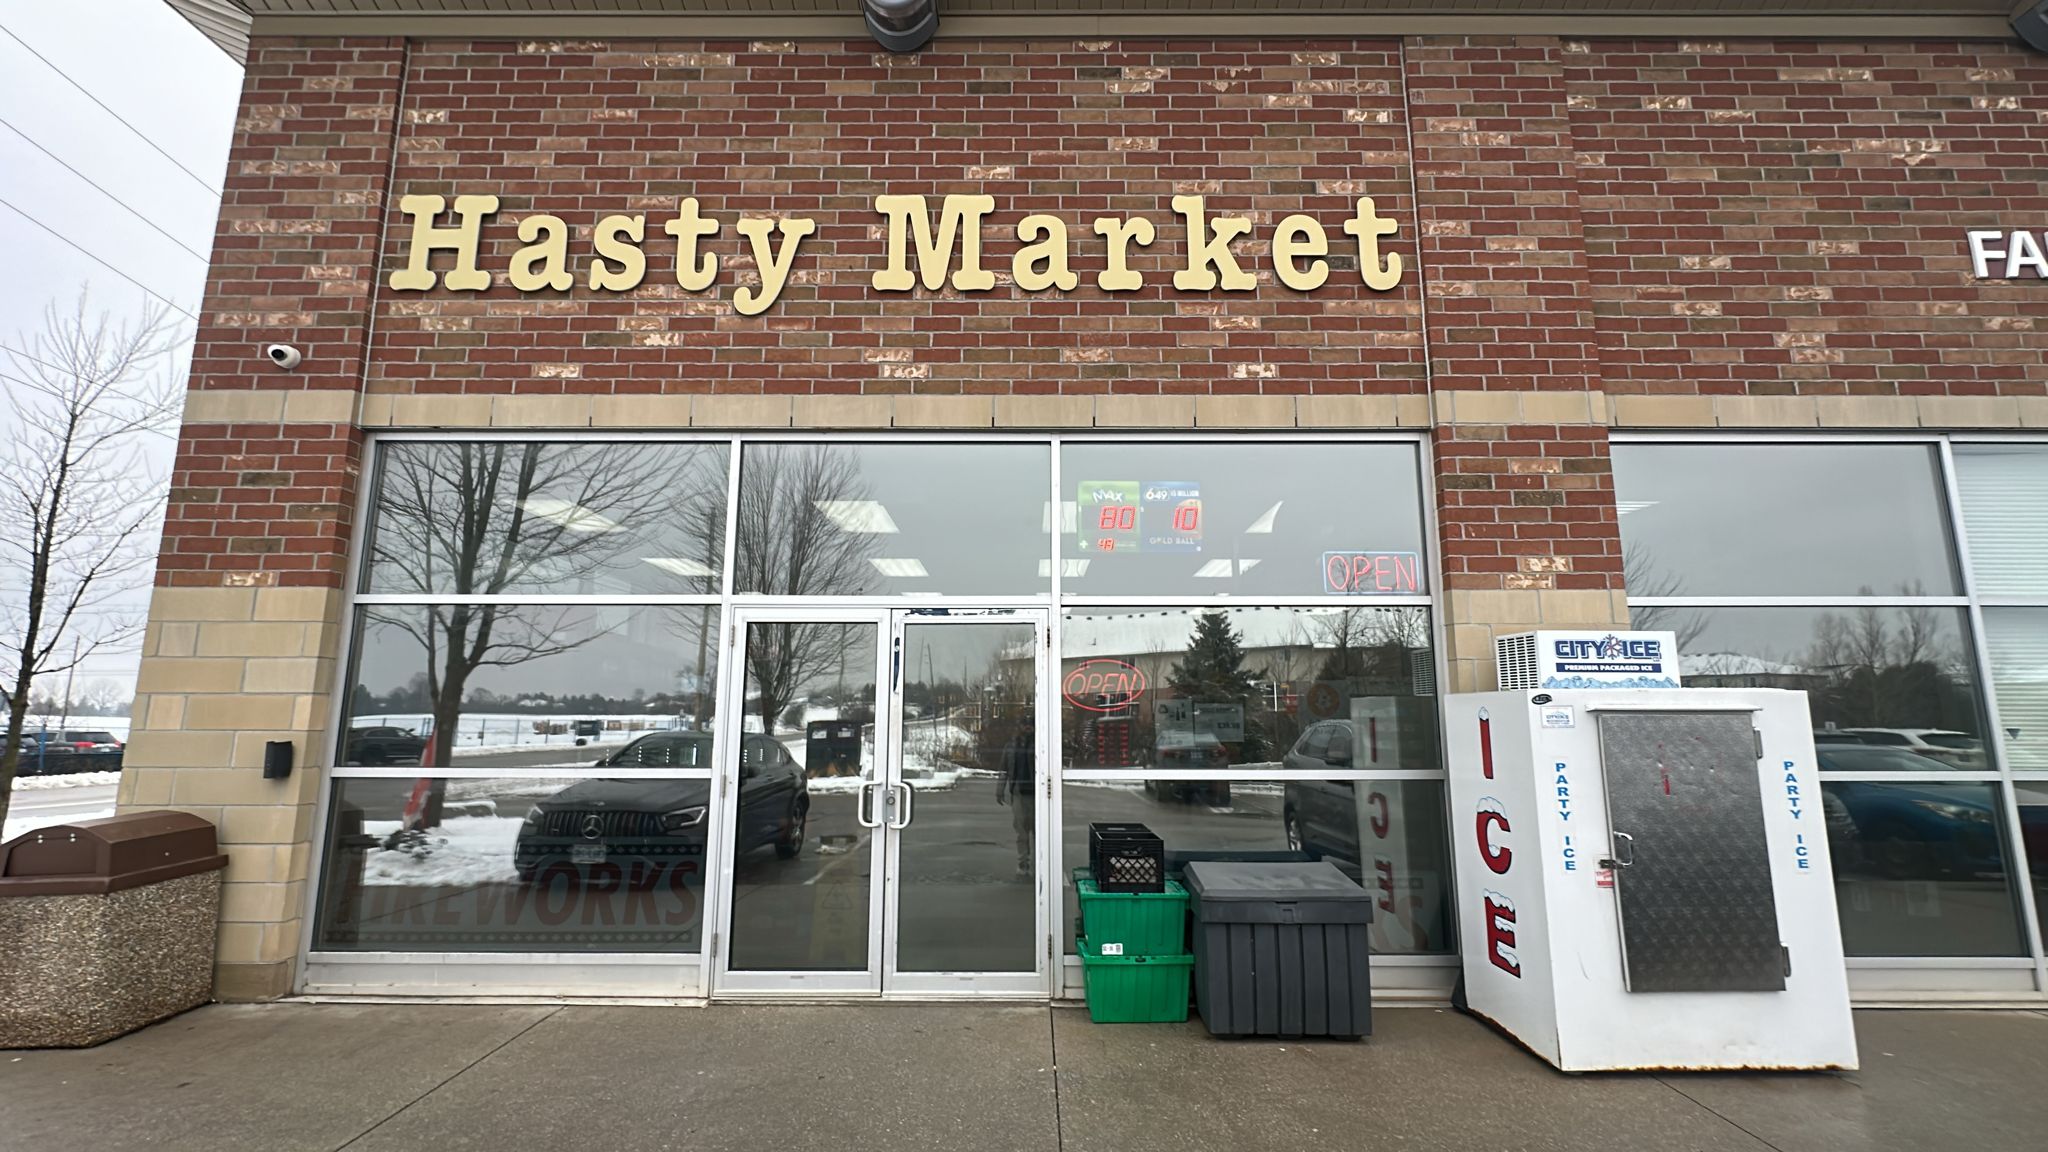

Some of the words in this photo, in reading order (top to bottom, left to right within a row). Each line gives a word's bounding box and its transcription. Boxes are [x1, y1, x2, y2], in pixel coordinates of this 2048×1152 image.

[389, 194, 816, 316] Hasty
[871, 193, 1403, 292] Market
[1967, 230, 2048, 279] FA
[1092, 488, 1125, 503] MAX
[1099, 505, 1136, 530] 80
[1172, 506, 1198, 531] 10
[1327, 555, 1416, 591] OPEN
[1555, 639, 1607, 659] CITY
[1621, 639, 1662, 660] ICE
[1067, 672, 1138, 699] OPEN
[1555, 762, 1571, 821] PARTY
[1563, 835, 1576, 871] ICE
[1783, 761, 1802, 819] PARTY
[1795, 834, 1809, 869] ICE
[1475, 706, 1522, 979] ICE
